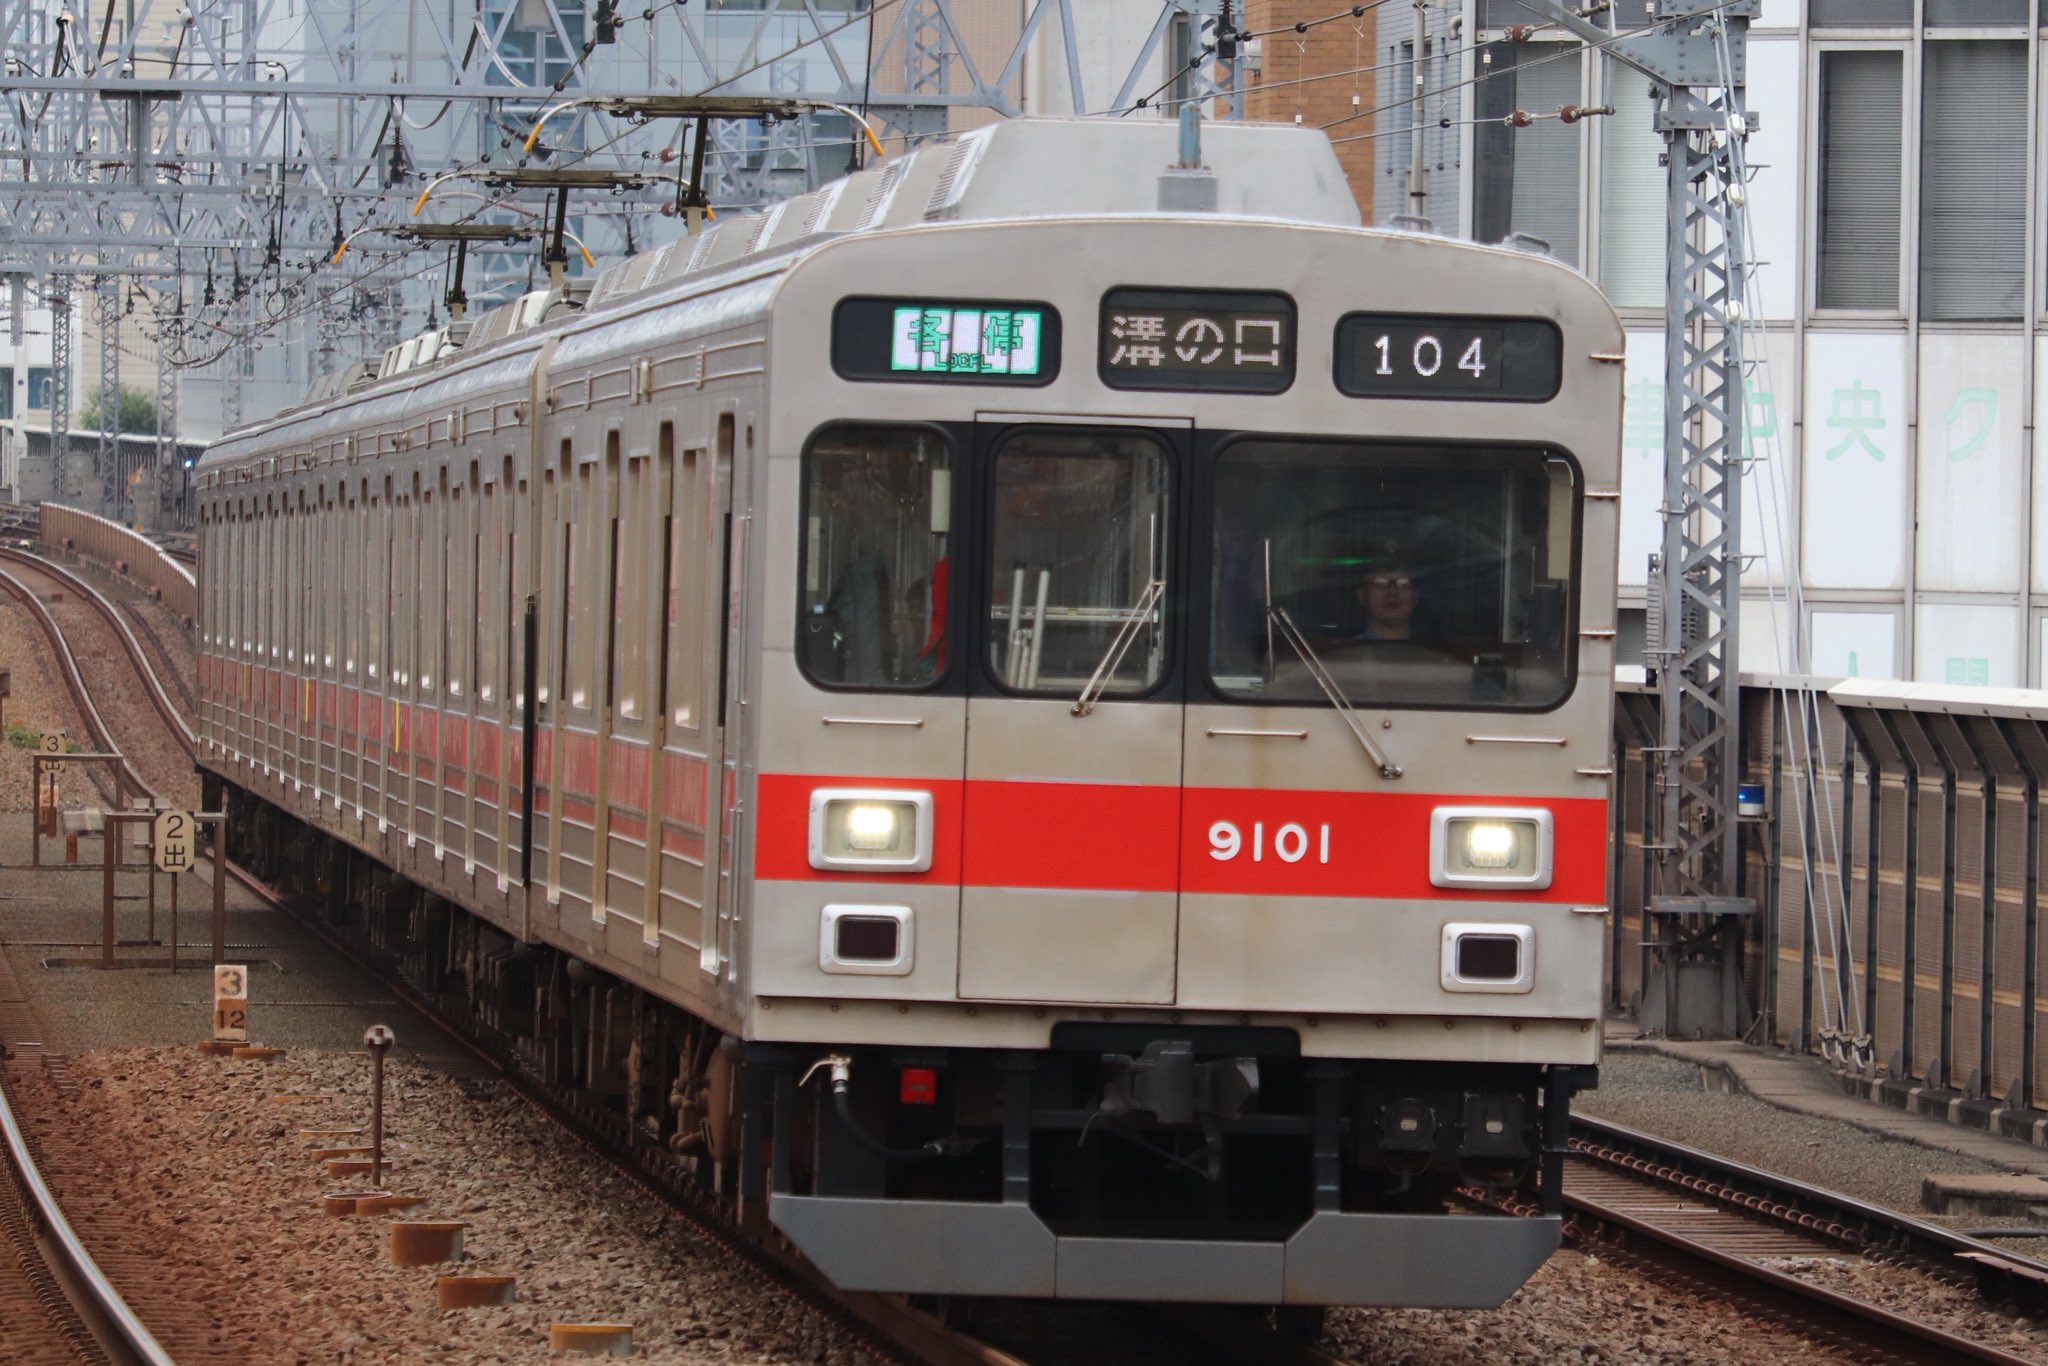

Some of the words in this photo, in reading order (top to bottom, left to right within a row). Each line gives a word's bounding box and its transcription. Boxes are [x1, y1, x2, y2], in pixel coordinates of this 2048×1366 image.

[1111, 315, 1280, 366] 溝の口
[1374, 335, 1487, 378] 104
[46, 736, 59, 752] 3
[166, 815, 184, 839] 2
[1208, 821, 1330, 864] 9101
[163, 844, 186, 867] 出
[220, 971, 243, 995] 3
[217, 1010, 245, 1029] 12
